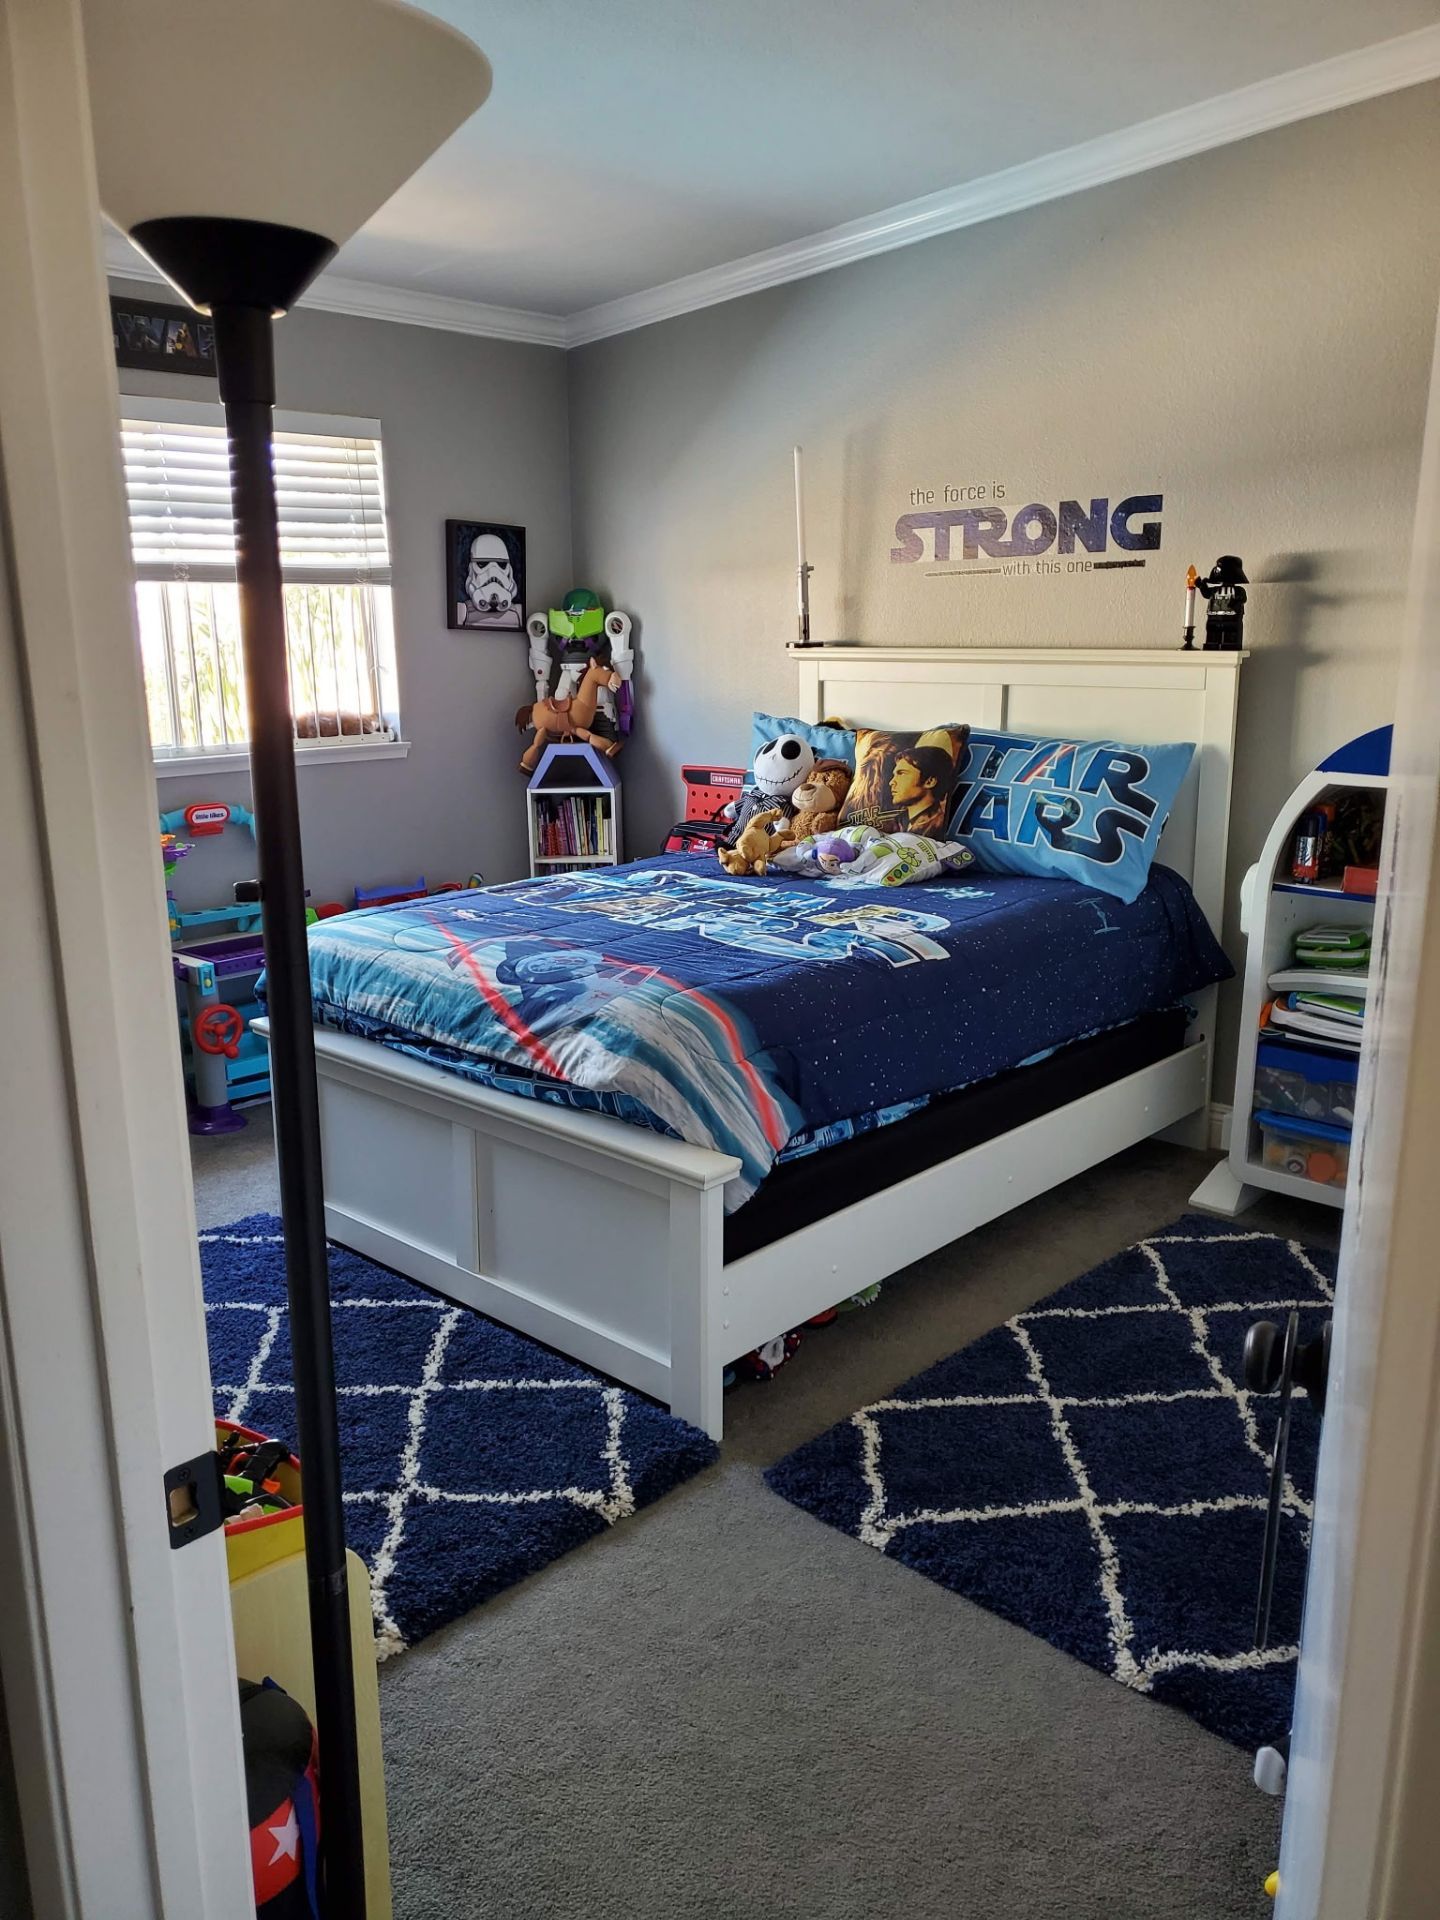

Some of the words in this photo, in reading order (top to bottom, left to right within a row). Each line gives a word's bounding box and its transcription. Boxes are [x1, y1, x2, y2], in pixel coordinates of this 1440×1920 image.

[909, 487, 935, 506] the
[943, 482, 986, 504] force
[992, 480, 1006, 499] is
[890, 494, 1164, 564] STRONG
[1002, 561, 1031, 576] with
[1035, 559, 1062, 575] this
[1066, 560, 1093, 574] one
[946, 781, 1151, 866] ARS
